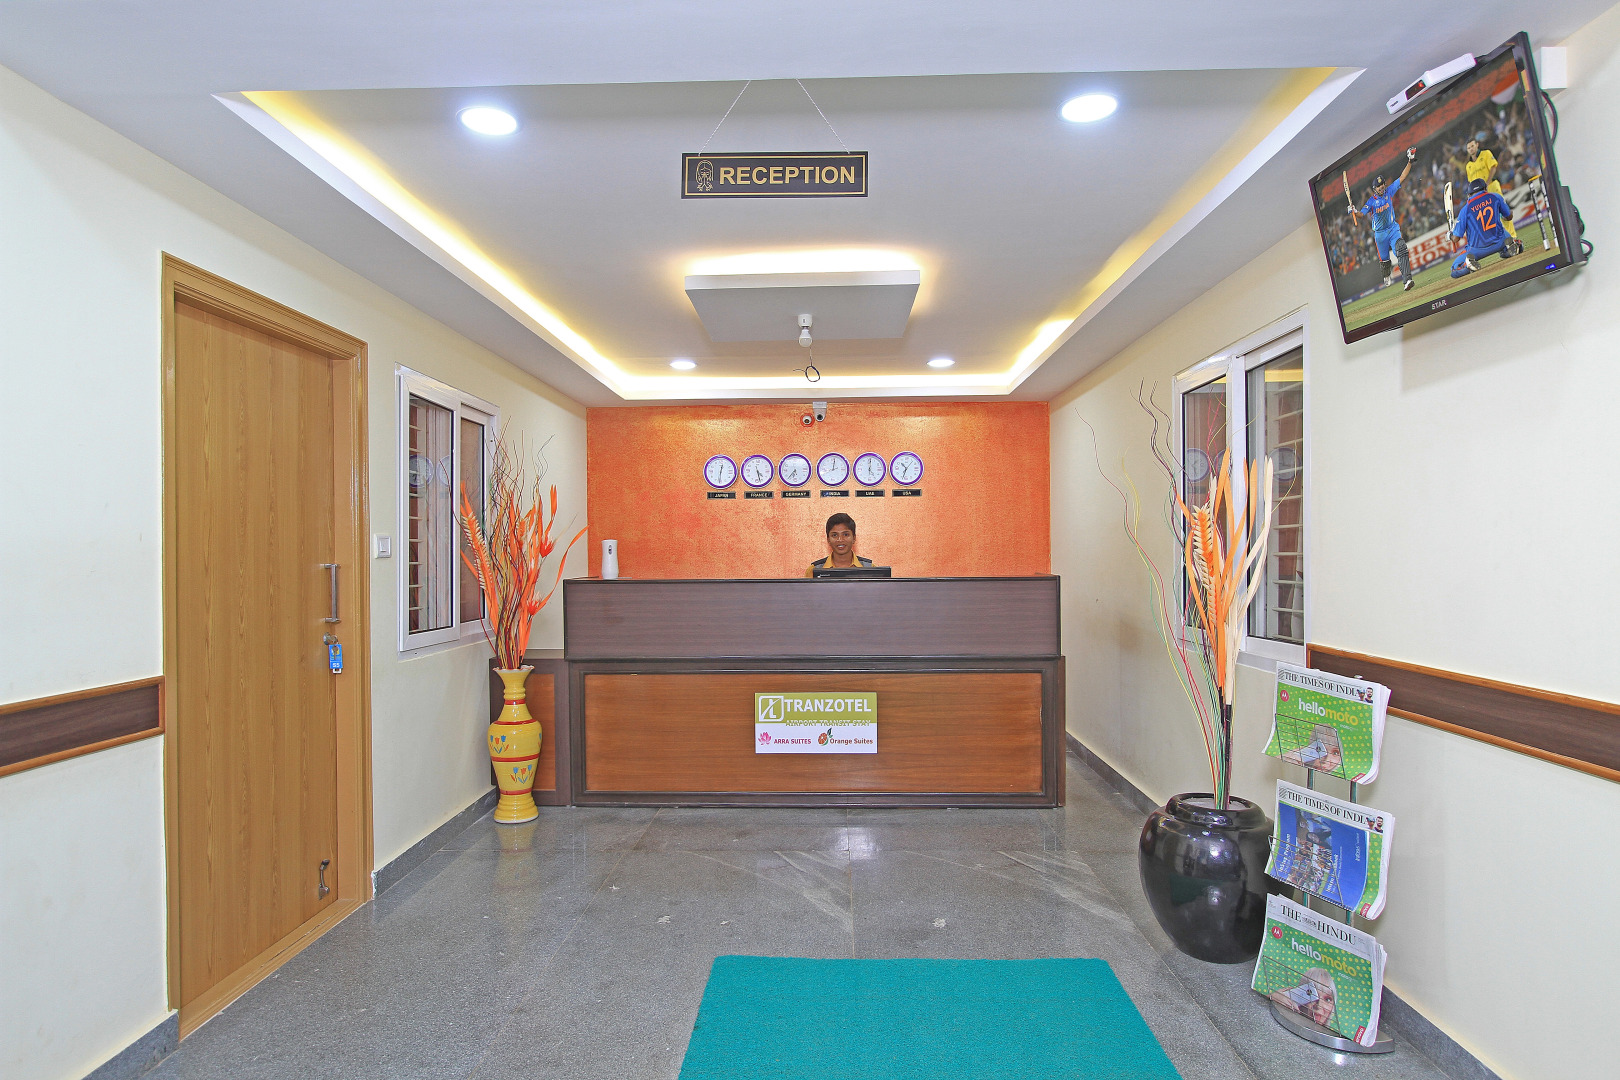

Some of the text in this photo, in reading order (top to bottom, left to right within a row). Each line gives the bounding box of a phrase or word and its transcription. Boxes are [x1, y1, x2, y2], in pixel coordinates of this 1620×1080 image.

[719, 166, 855, 185] RECEPTION
[1471, 198, 1492, 212] YUVRAJ
[1476, 206, 1496, 232] 12
[1432, 300, 1447, 310] STAR
[1285, 671, 1299, 683] THE
[1300, 675, 1324, 688] TIMES
[1324, 681, 1334, 691] OF
[784, 699, 872, 712] TRANZOTEL
[1287, 791, 1303, 803] THE
[1304, 797, 1329, 812] TIMES
[1330, 804, 1342, 816] OF
[1281, 904, 1302, 923] THE
[1317, 920, 1357, 945] HINDU
